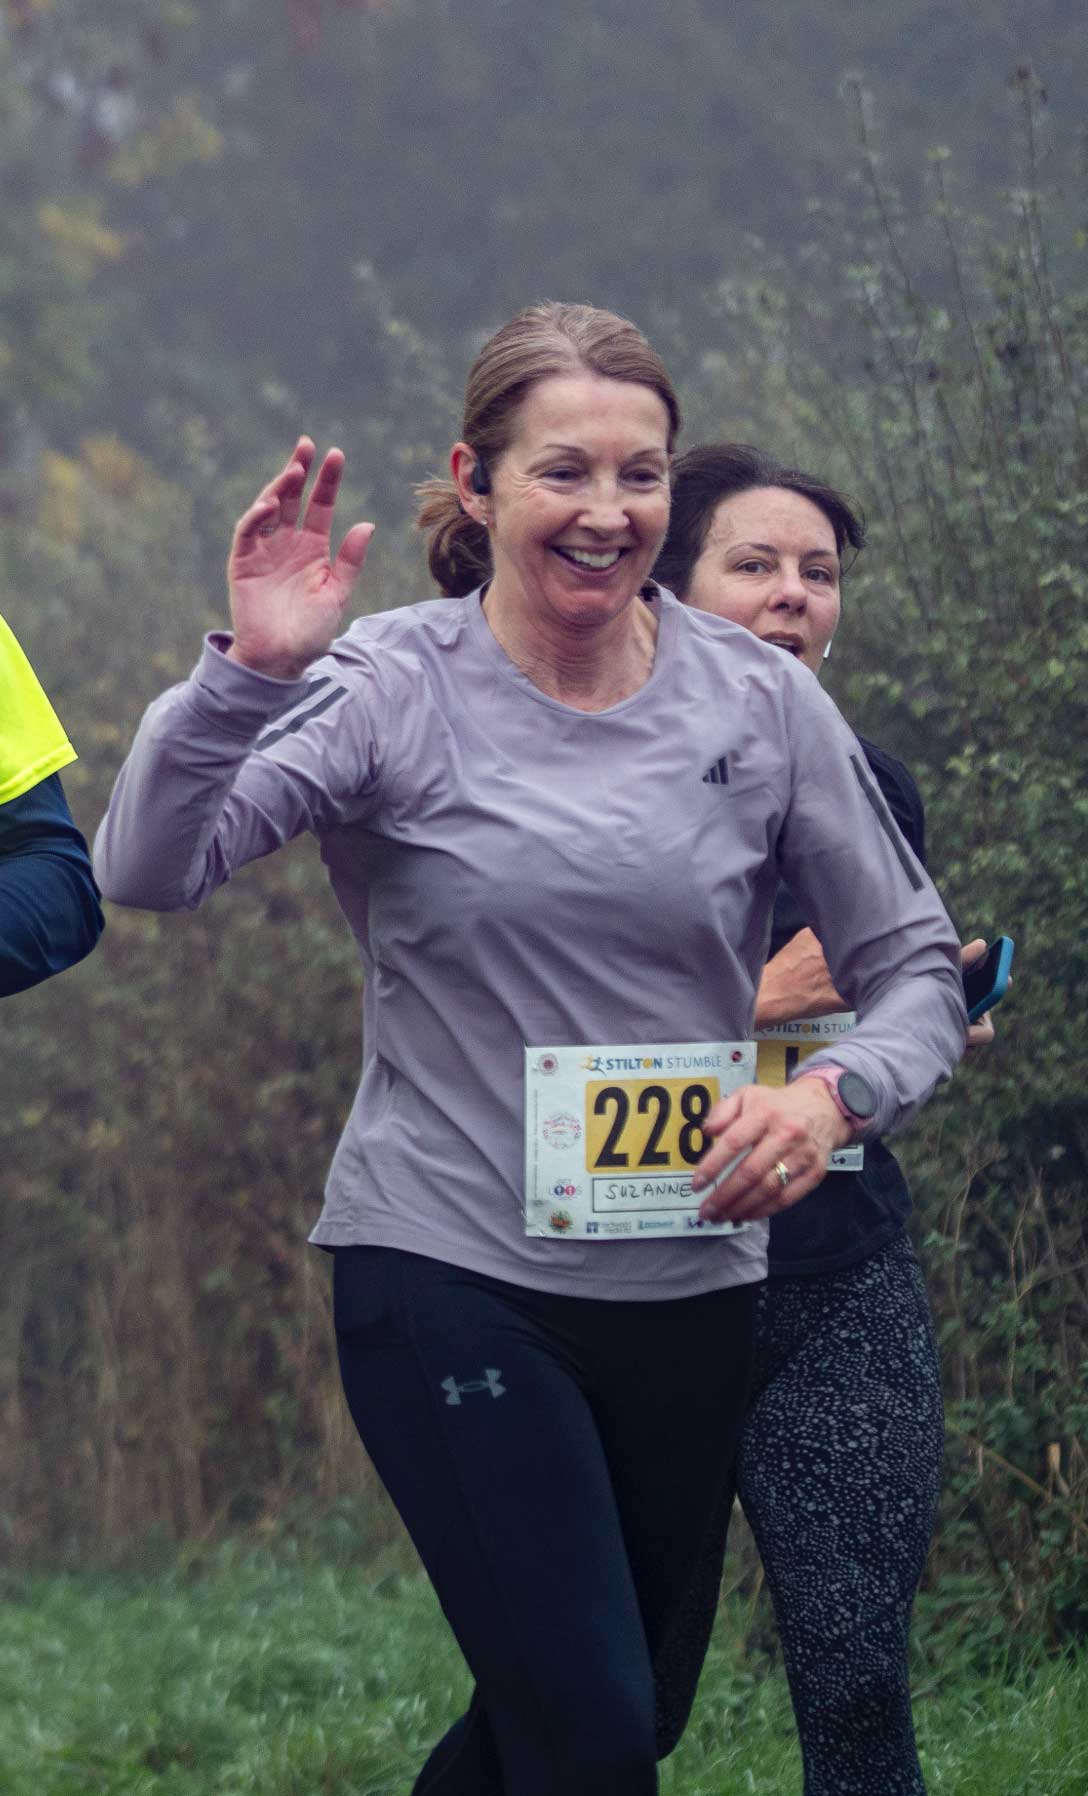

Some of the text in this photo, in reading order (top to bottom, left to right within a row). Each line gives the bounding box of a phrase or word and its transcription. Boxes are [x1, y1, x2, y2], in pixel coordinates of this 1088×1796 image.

[606, 1055, 722, 1071] STILTON STUMBLE
[593, 1084, 711, 1168] 228
[605, 1182, 692, 1202] SUZANNE
